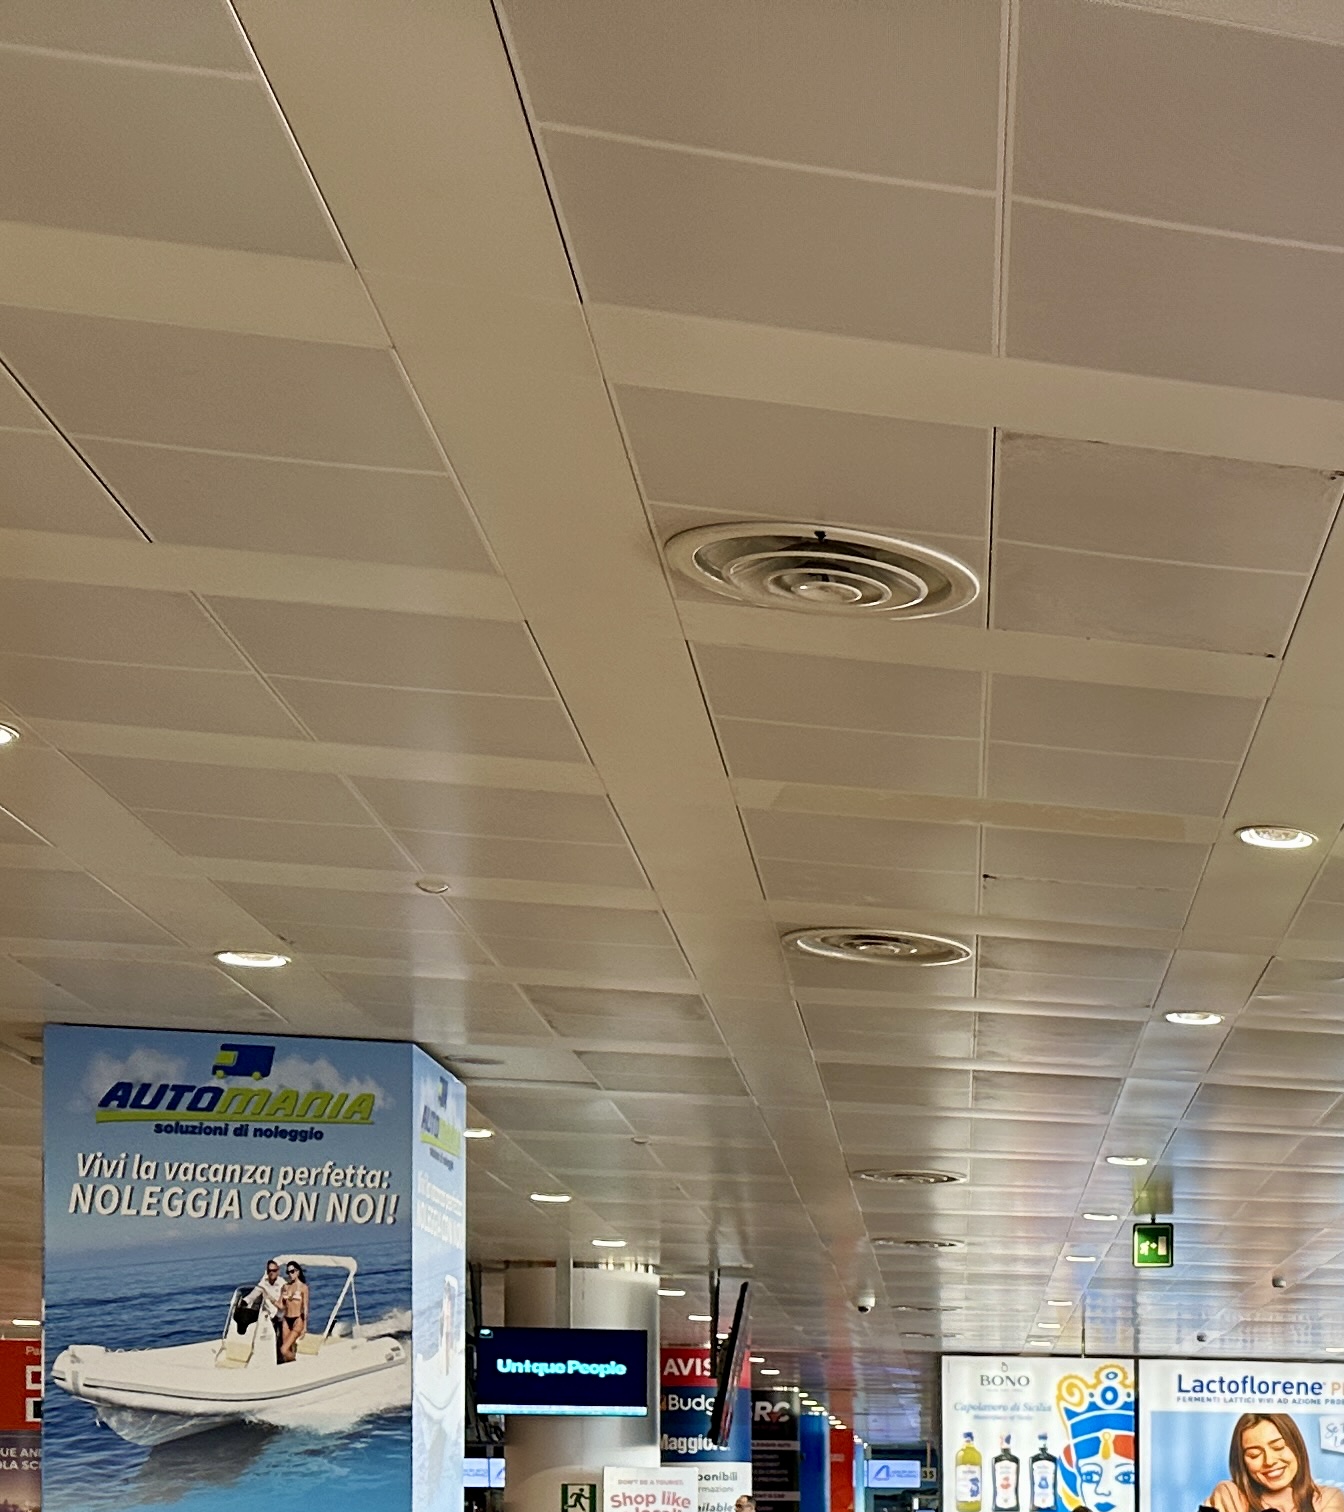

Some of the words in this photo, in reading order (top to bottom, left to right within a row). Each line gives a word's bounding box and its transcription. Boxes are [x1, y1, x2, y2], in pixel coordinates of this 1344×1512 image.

[154, 1120, 229, 1138] soluzioni
[233, 1124, 249, 1139] di
[254, 1126, 324, 1143] noleggio
[77, 1151, 125, 1179] Vivi
[133, 1153, 158, 1181] la
[164, 1159, 271, 1186] vacanza
[278, 1161, 392, 1191] perfetta:
[68, 1182, 242, 1222] NOLEGGIA
[250, 1188, 318, 1223] CON
[326, 1193, 400, 1225] NOI!
[567, 1359, 628, 1378] People
[663, 1357, 712, 1377] AVIS
[980, 1374, 1030, 1387] BONO
[1177, 1374, 1323, 1396] Lactoflorene
[1176, 1396, 1220, 1404] FERMENTI
[1277, 1397, 1289, 1405] AD
[610, 1492, 657, 1508] Shop
[661, 1490, 691, 1509] like
